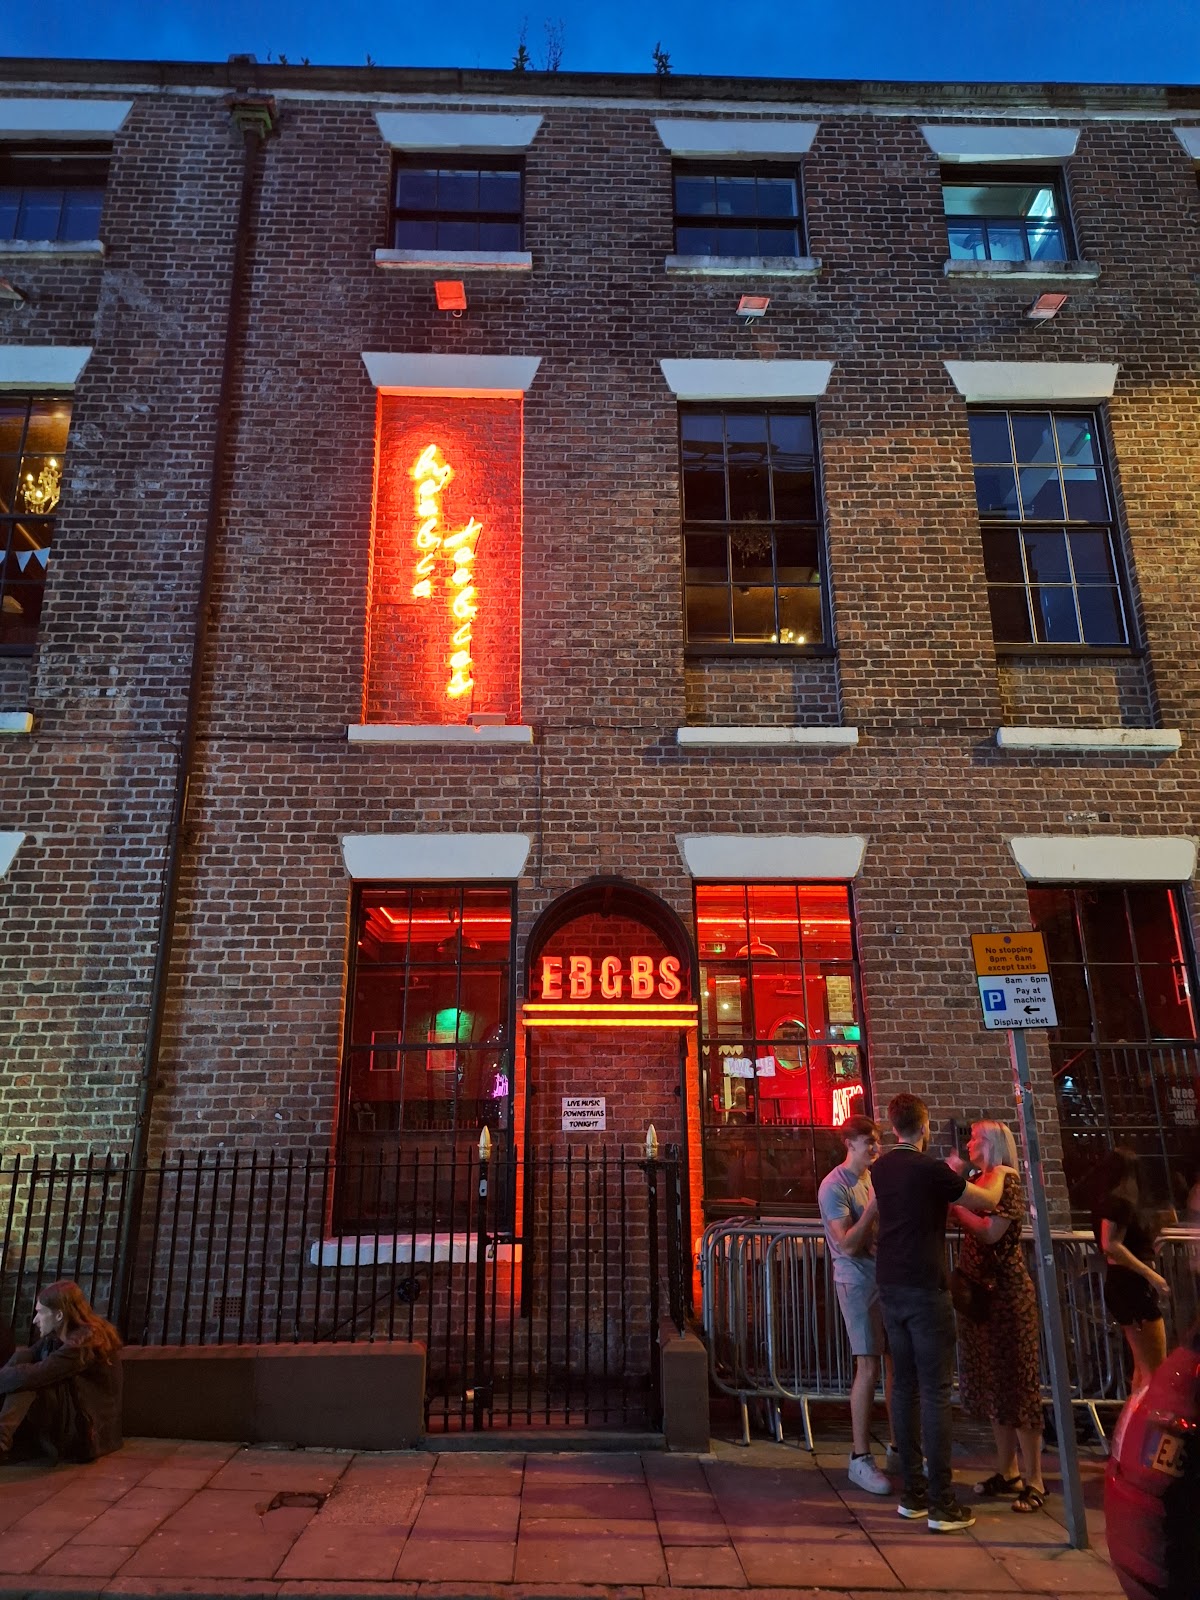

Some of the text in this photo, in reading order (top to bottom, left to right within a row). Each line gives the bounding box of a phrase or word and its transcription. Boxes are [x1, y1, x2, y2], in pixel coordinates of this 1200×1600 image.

[999, 945, 1033, 954] stopping
[1014, 954, 1032, 962] 6am
[541, 955, 682, 1000] EBGBS
[1005, 976, 1023, 984] 8am
[1016, 987, 1030, 995] Pay
[988, 991, 1002, 1009] P
[1013, 996, 1046, 1004] machine
[993, 1017, 1048, 1026] Display ticket
[1171, 1086, 1195, 1099] free
[569, 1120, 599, 1128] TONIGHT
